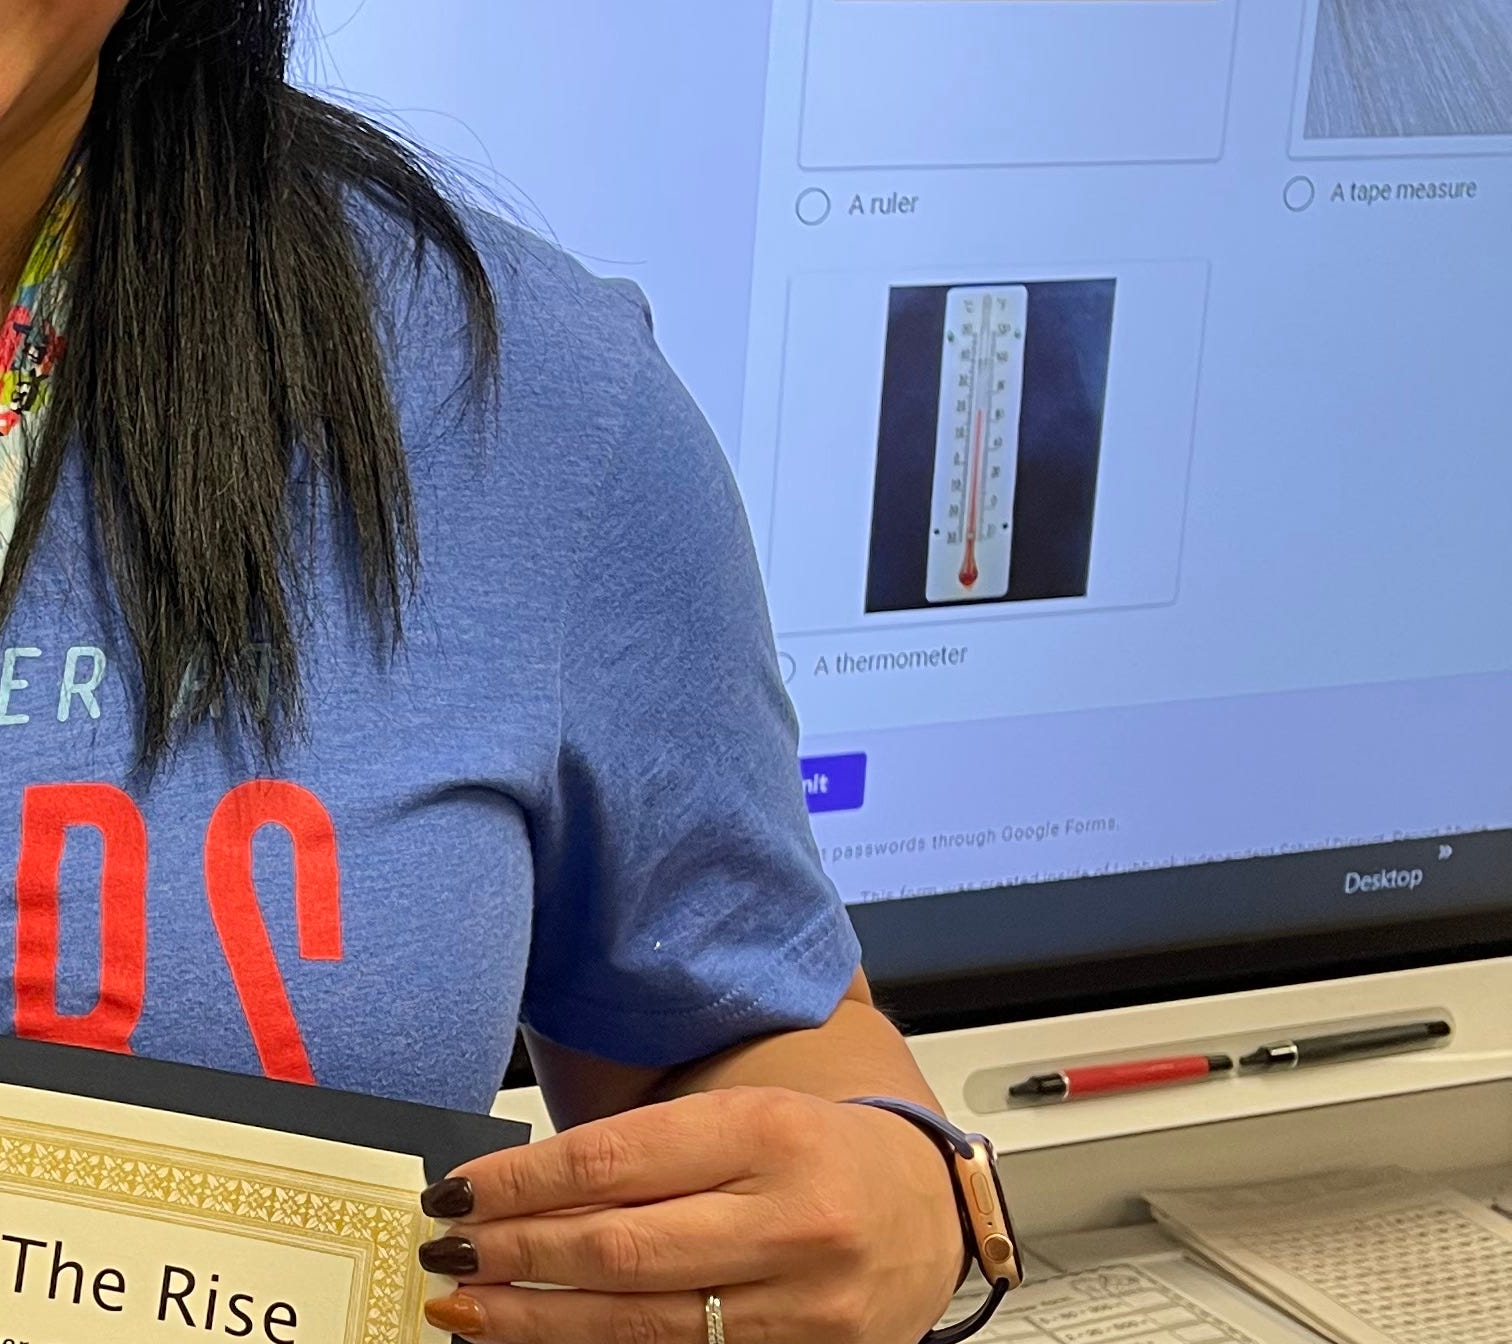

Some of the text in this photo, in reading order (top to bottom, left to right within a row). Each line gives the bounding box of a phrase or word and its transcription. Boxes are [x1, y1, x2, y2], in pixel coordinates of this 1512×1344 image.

[847, 192, 919, 216] A ruler
[1330, 177, 1478, 207] A tape measure
[813, 645, 968, 677] A thermometer
[832, 836, 926, 863] passwords
[932, 828, 997, 851] through
[1001, 821, 1060, 844] Google
[1344, 868, 1423, 894] Desktop
[0, 1233, 127, 1313] The
